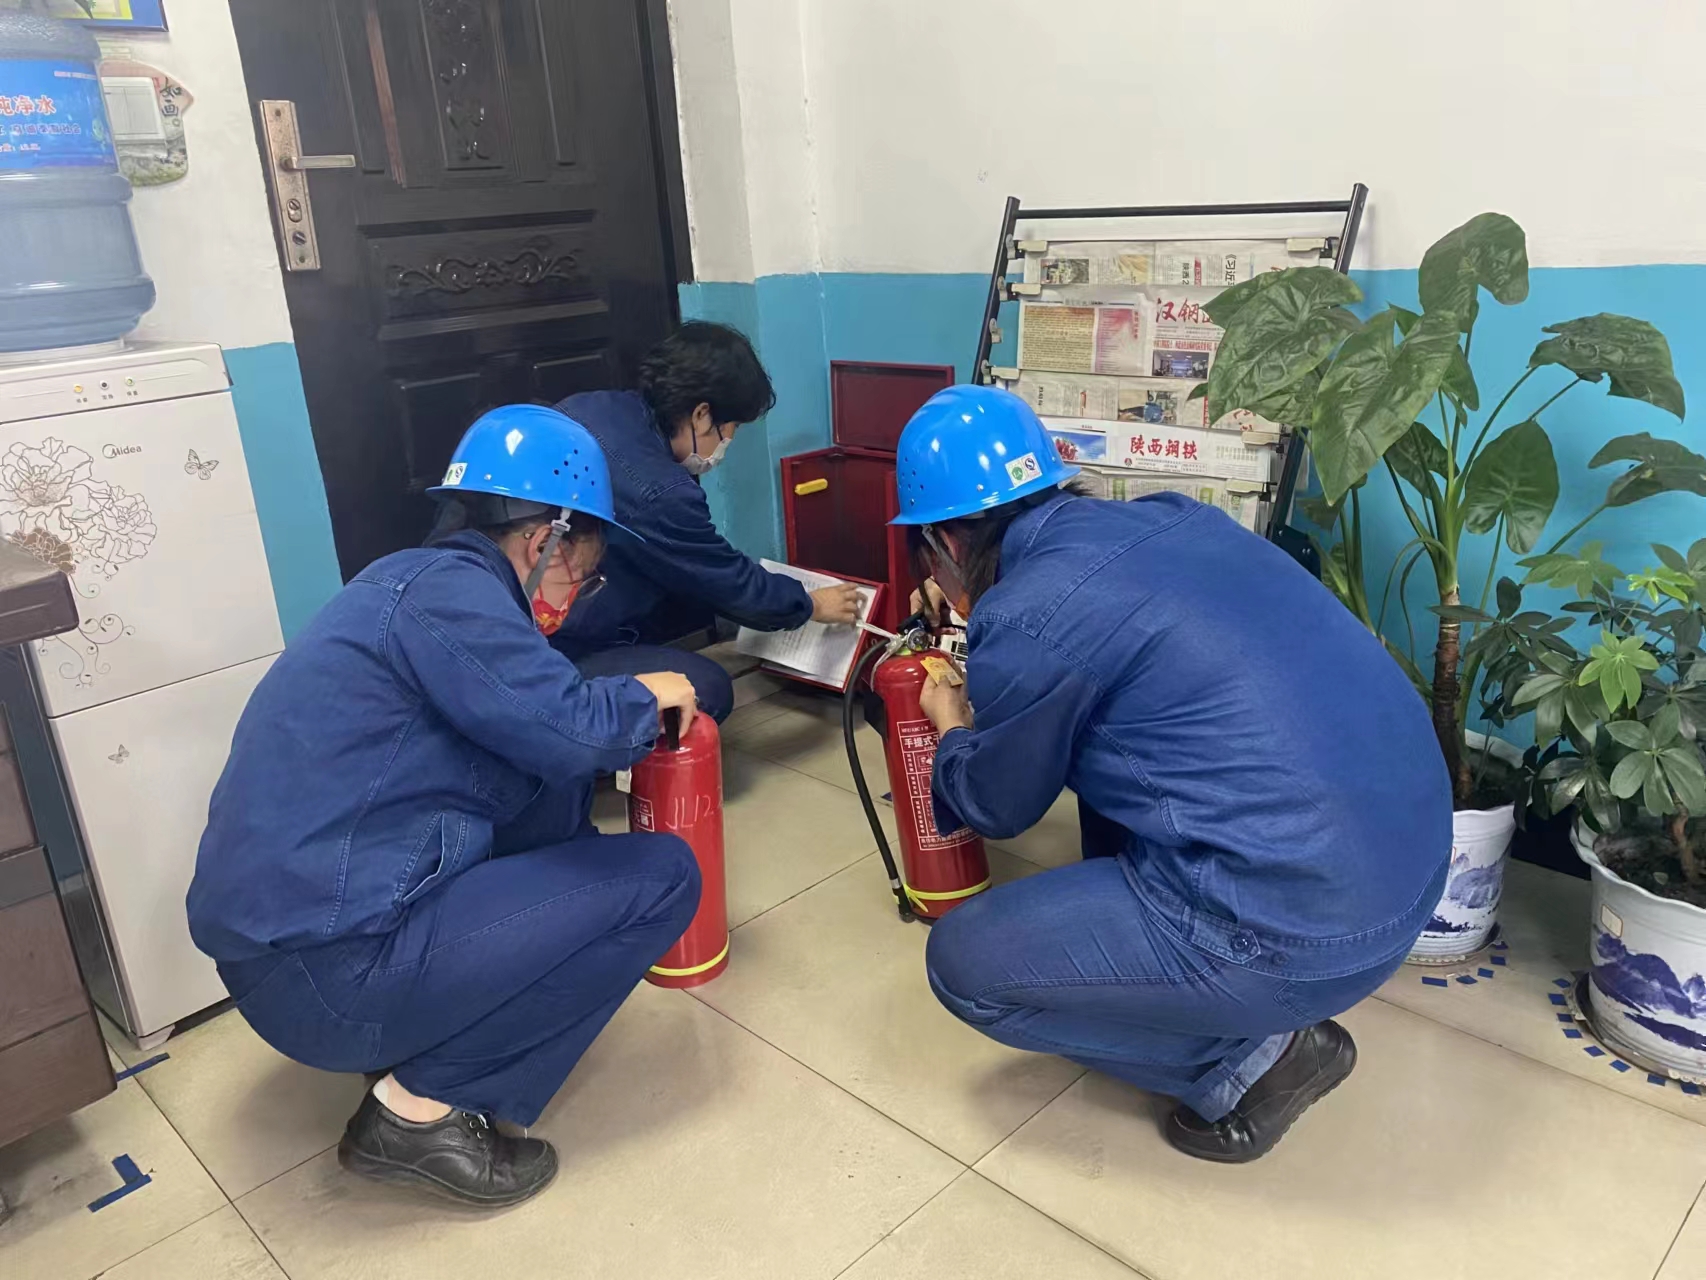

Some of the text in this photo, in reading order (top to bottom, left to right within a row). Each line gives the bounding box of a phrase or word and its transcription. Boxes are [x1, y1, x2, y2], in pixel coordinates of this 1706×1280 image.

[0, 95, 56, 115] 纯净水
[102, 443, 142, 459] Midea
